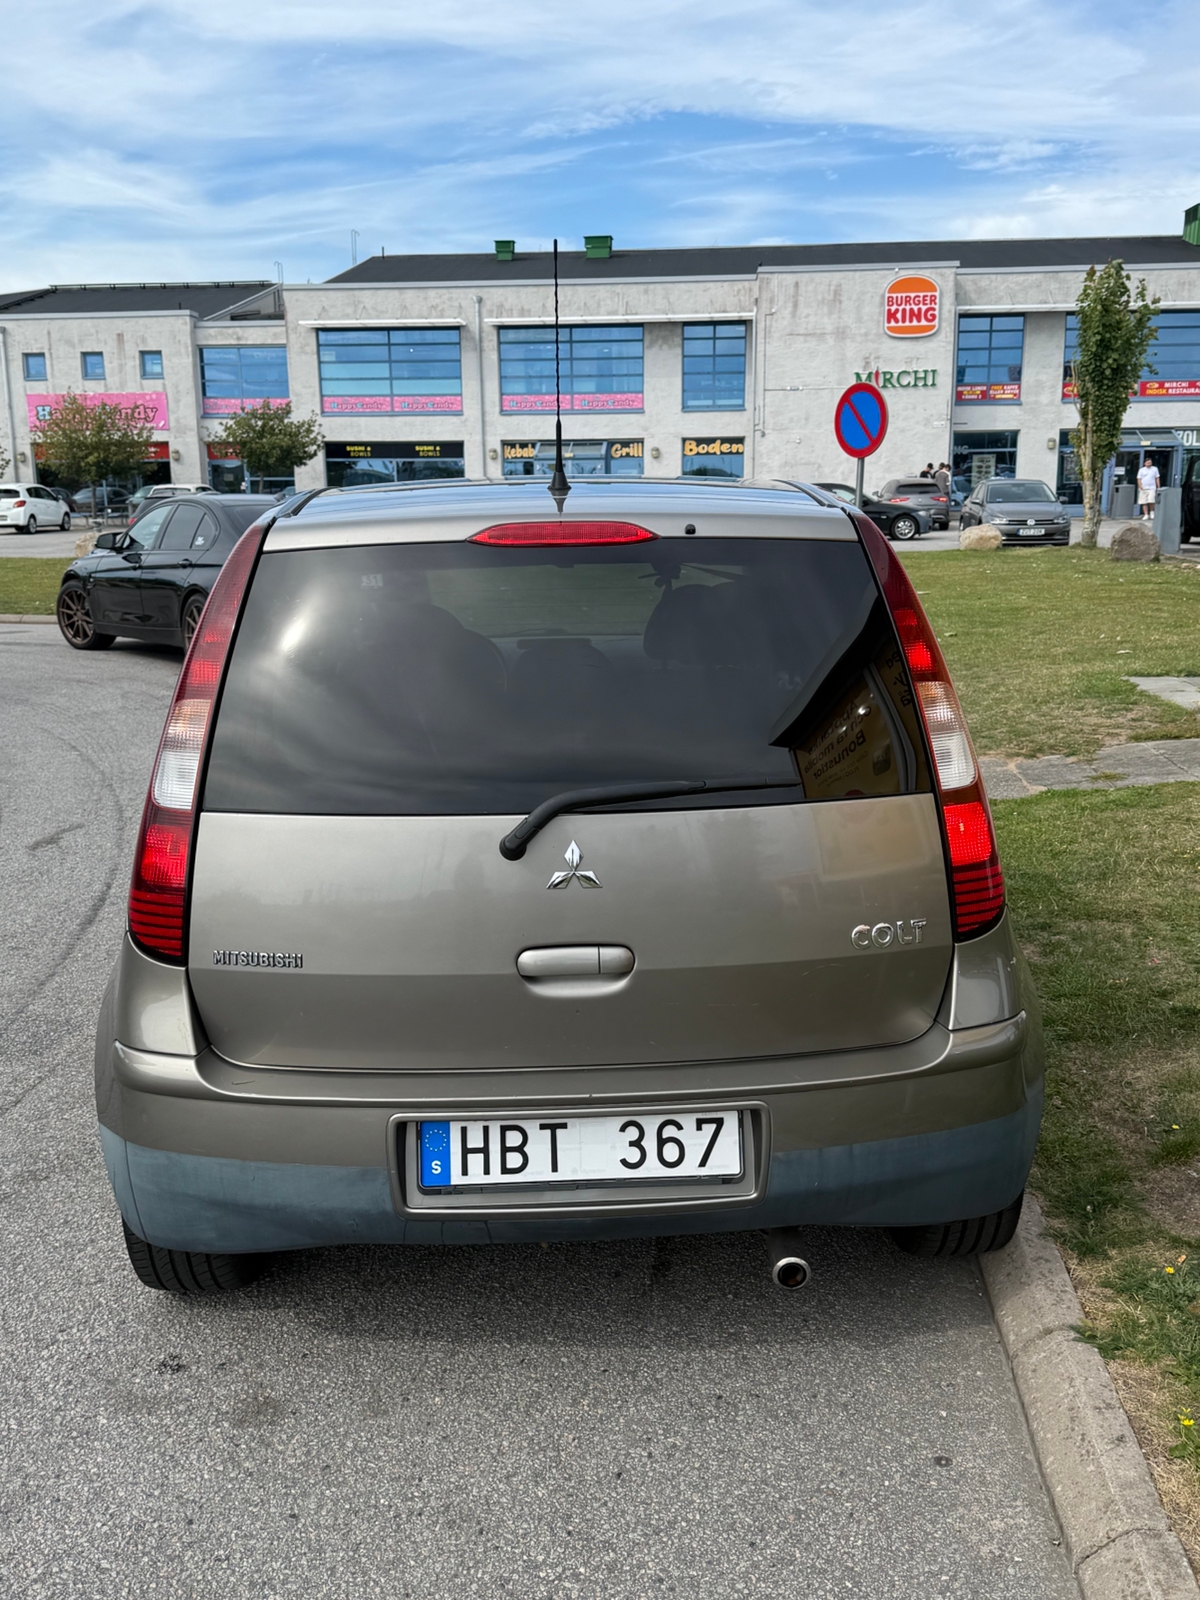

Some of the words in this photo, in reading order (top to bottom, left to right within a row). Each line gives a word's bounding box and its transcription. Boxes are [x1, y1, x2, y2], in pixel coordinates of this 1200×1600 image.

[887, 295, 937, 307] BURGER
[886, 307, 937, 324] KING
[504, 443, 535, 459] Kebab
[611, 442, 643, 458] Grill
[684, 439, 744, 456] Boden
[851, 917, 927, 950] COLT
[213, 949, 303, 969] MITSUBISHI
[460, 1121, 568, 1177] HBT
[618, 1117, 725, 1170] 367
[431, 1160, 442, 1175] S
